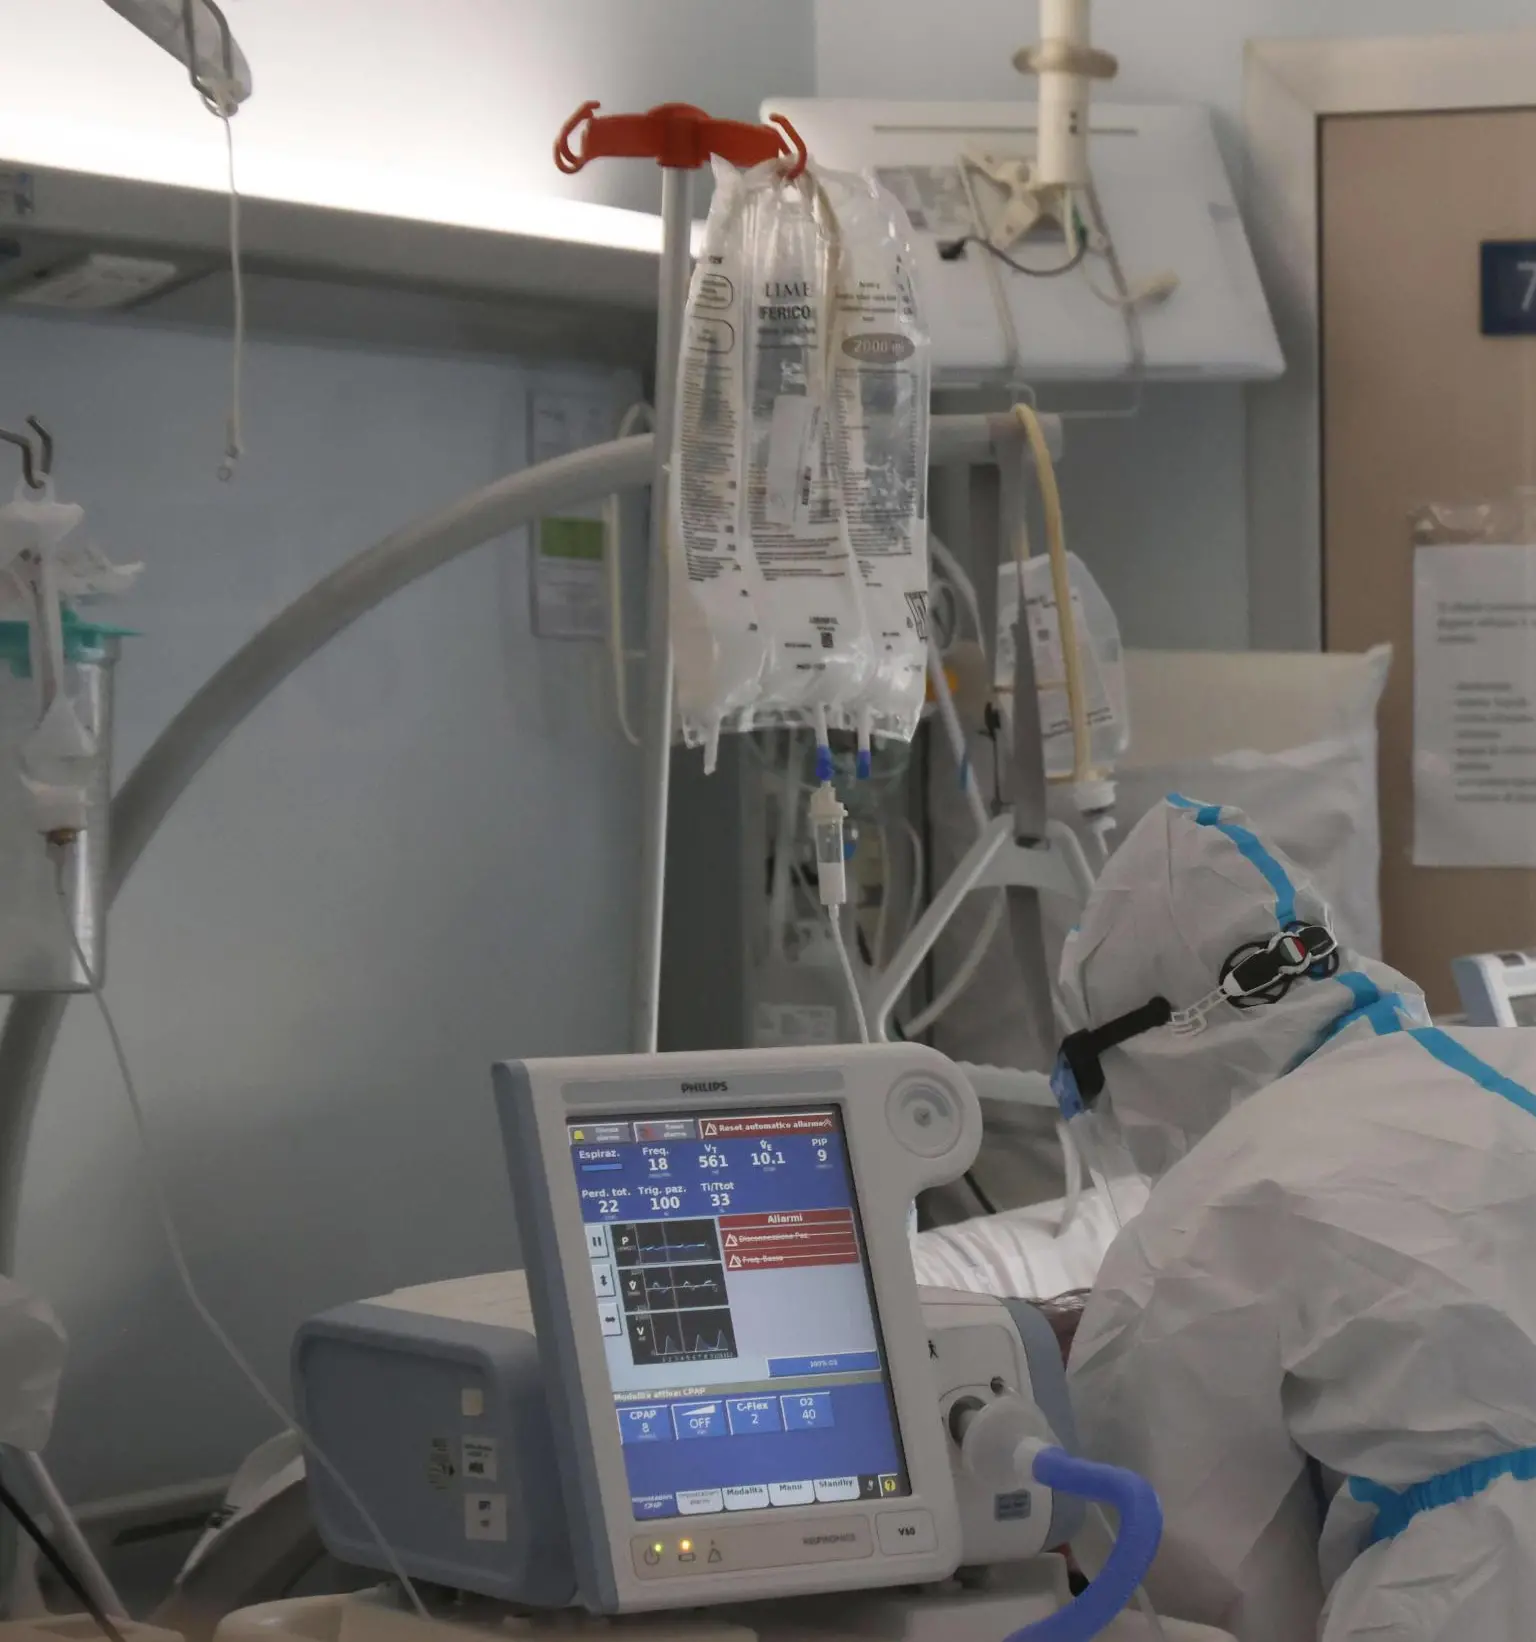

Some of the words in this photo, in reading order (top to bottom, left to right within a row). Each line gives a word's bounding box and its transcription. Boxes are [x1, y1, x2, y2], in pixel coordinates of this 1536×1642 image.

[681, 1082, 728, 1093] PHILIPS
[719, 1124, 742, 1132] Reset
[745, 1122, 791, 1131] automatico
[812, 1138, 828, 1147] PIP
[579, 1150, 620, 1160] Espiraz.
[642, 1147, 670, 1157] Freq.
[817, 1149, 827, 1161] 9
[699, 1155, 728, 1168] 561
[751, 1152, 785, 1165] 10.1
[648, 1158, 668, 1171] 18
[582, 1189, 609, 1198] Perd.
[612, 1187, 631, 1196] tot.
[638, 1186, 661, 1196] Trig.
[665, 1185, 687, 1195] paz.
[650, 1196, 680, 1210] 100
[710, 1193, 730, 1207] 33
[598, 1200, 619, 1213] 22
[767, 1213, 803, 1223] Allarmi
[622, 1236, 629, 1245] P
[637, 1326, 644, 1336] V
[683, 1387, 706, 1396] CPAP
[737, 1402, 768, 1411] C-Flex
[630, 1410, 656, 1420] CPAP
[752, 1414, 759, 1425] 2
[802, 1409, 816, 1420] 40
[642, 1422, 649, 1433] 8
[689, 1417, 711, 1429] OFF
